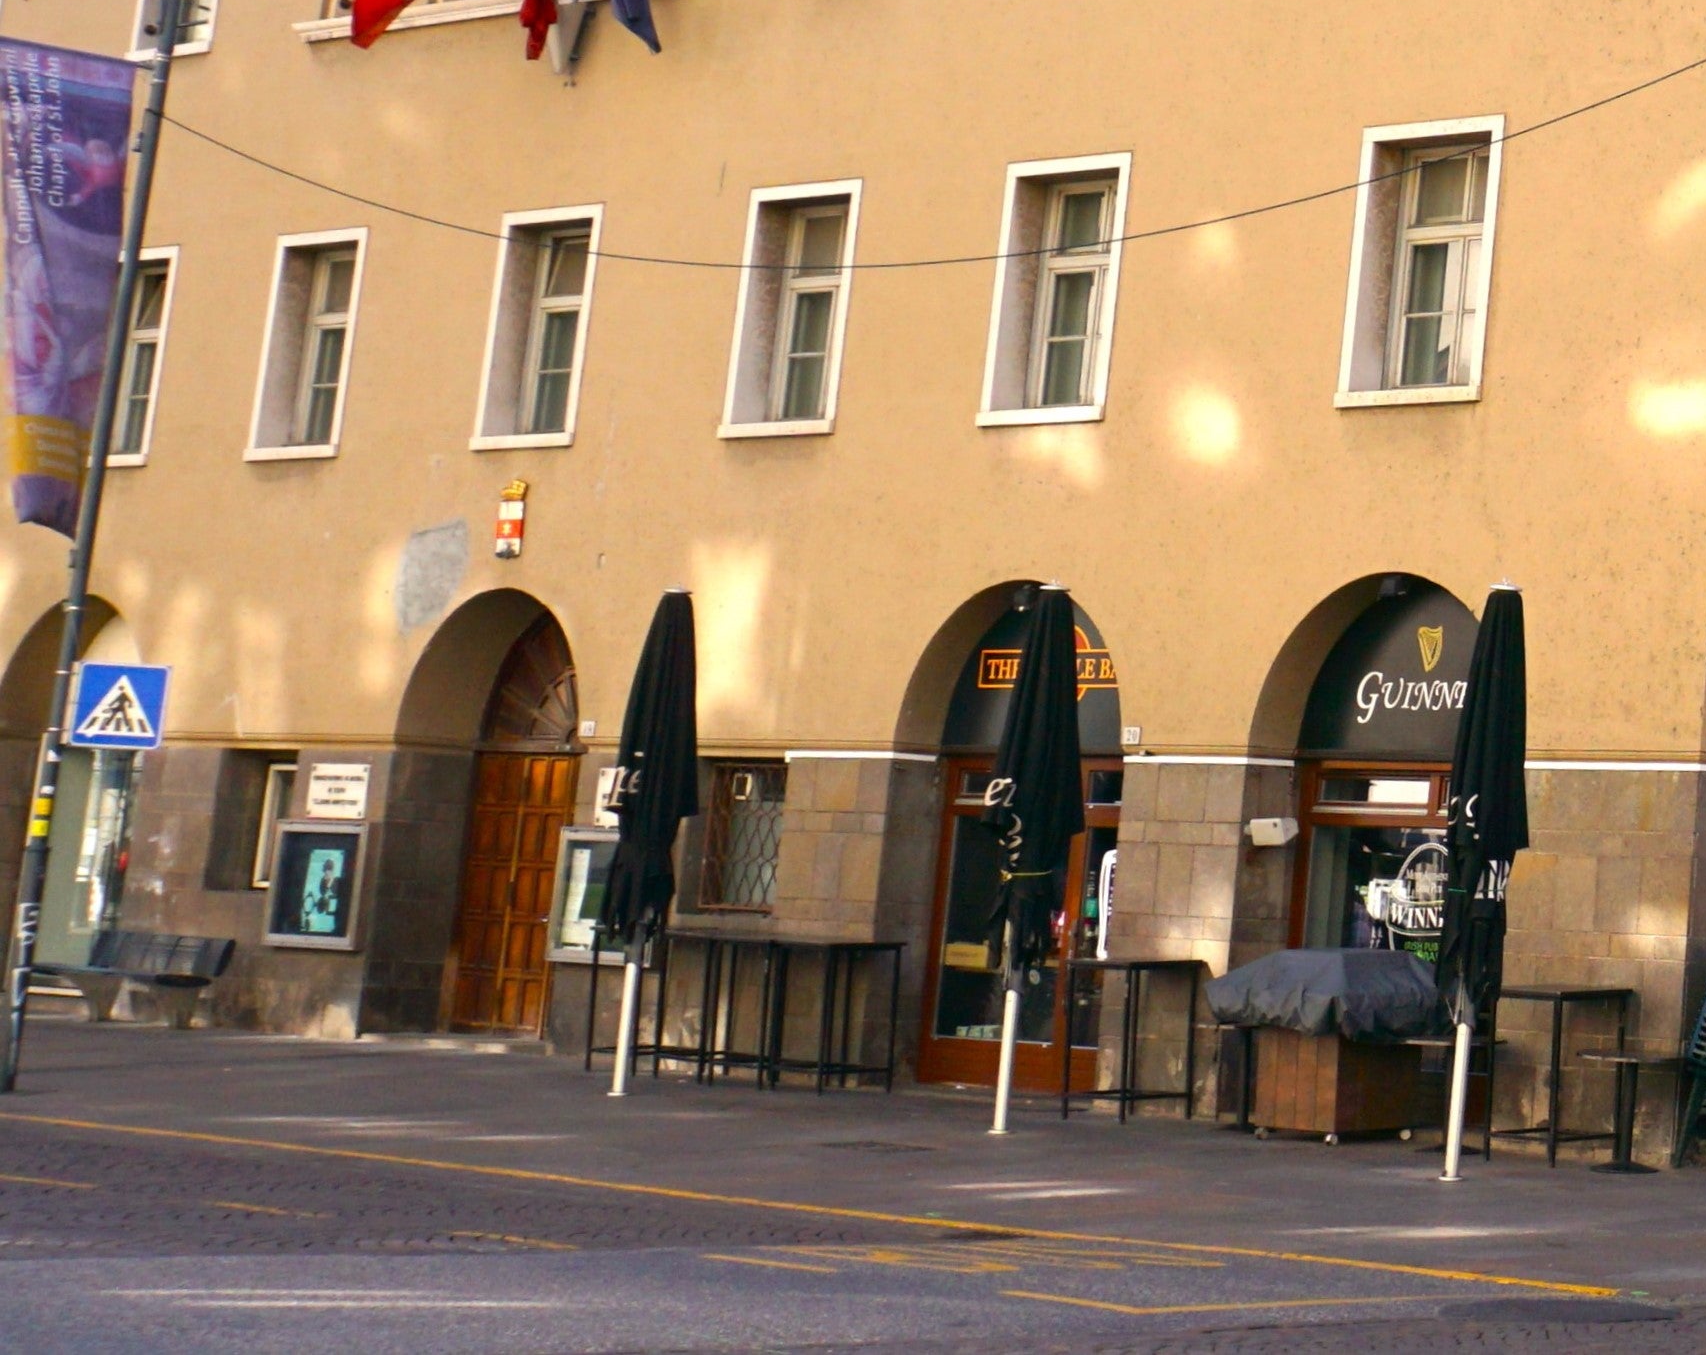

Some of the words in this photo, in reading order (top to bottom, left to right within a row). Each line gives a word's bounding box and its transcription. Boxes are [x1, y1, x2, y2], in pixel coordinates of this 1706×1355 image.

[46, 56, 62, 98] John
[25, 52, 44, 195] Johanneskapelle
[47, 100, 62, 122] St.
[47, 124, 62, 144] of
[47, 146, 67, 207] Chapel
